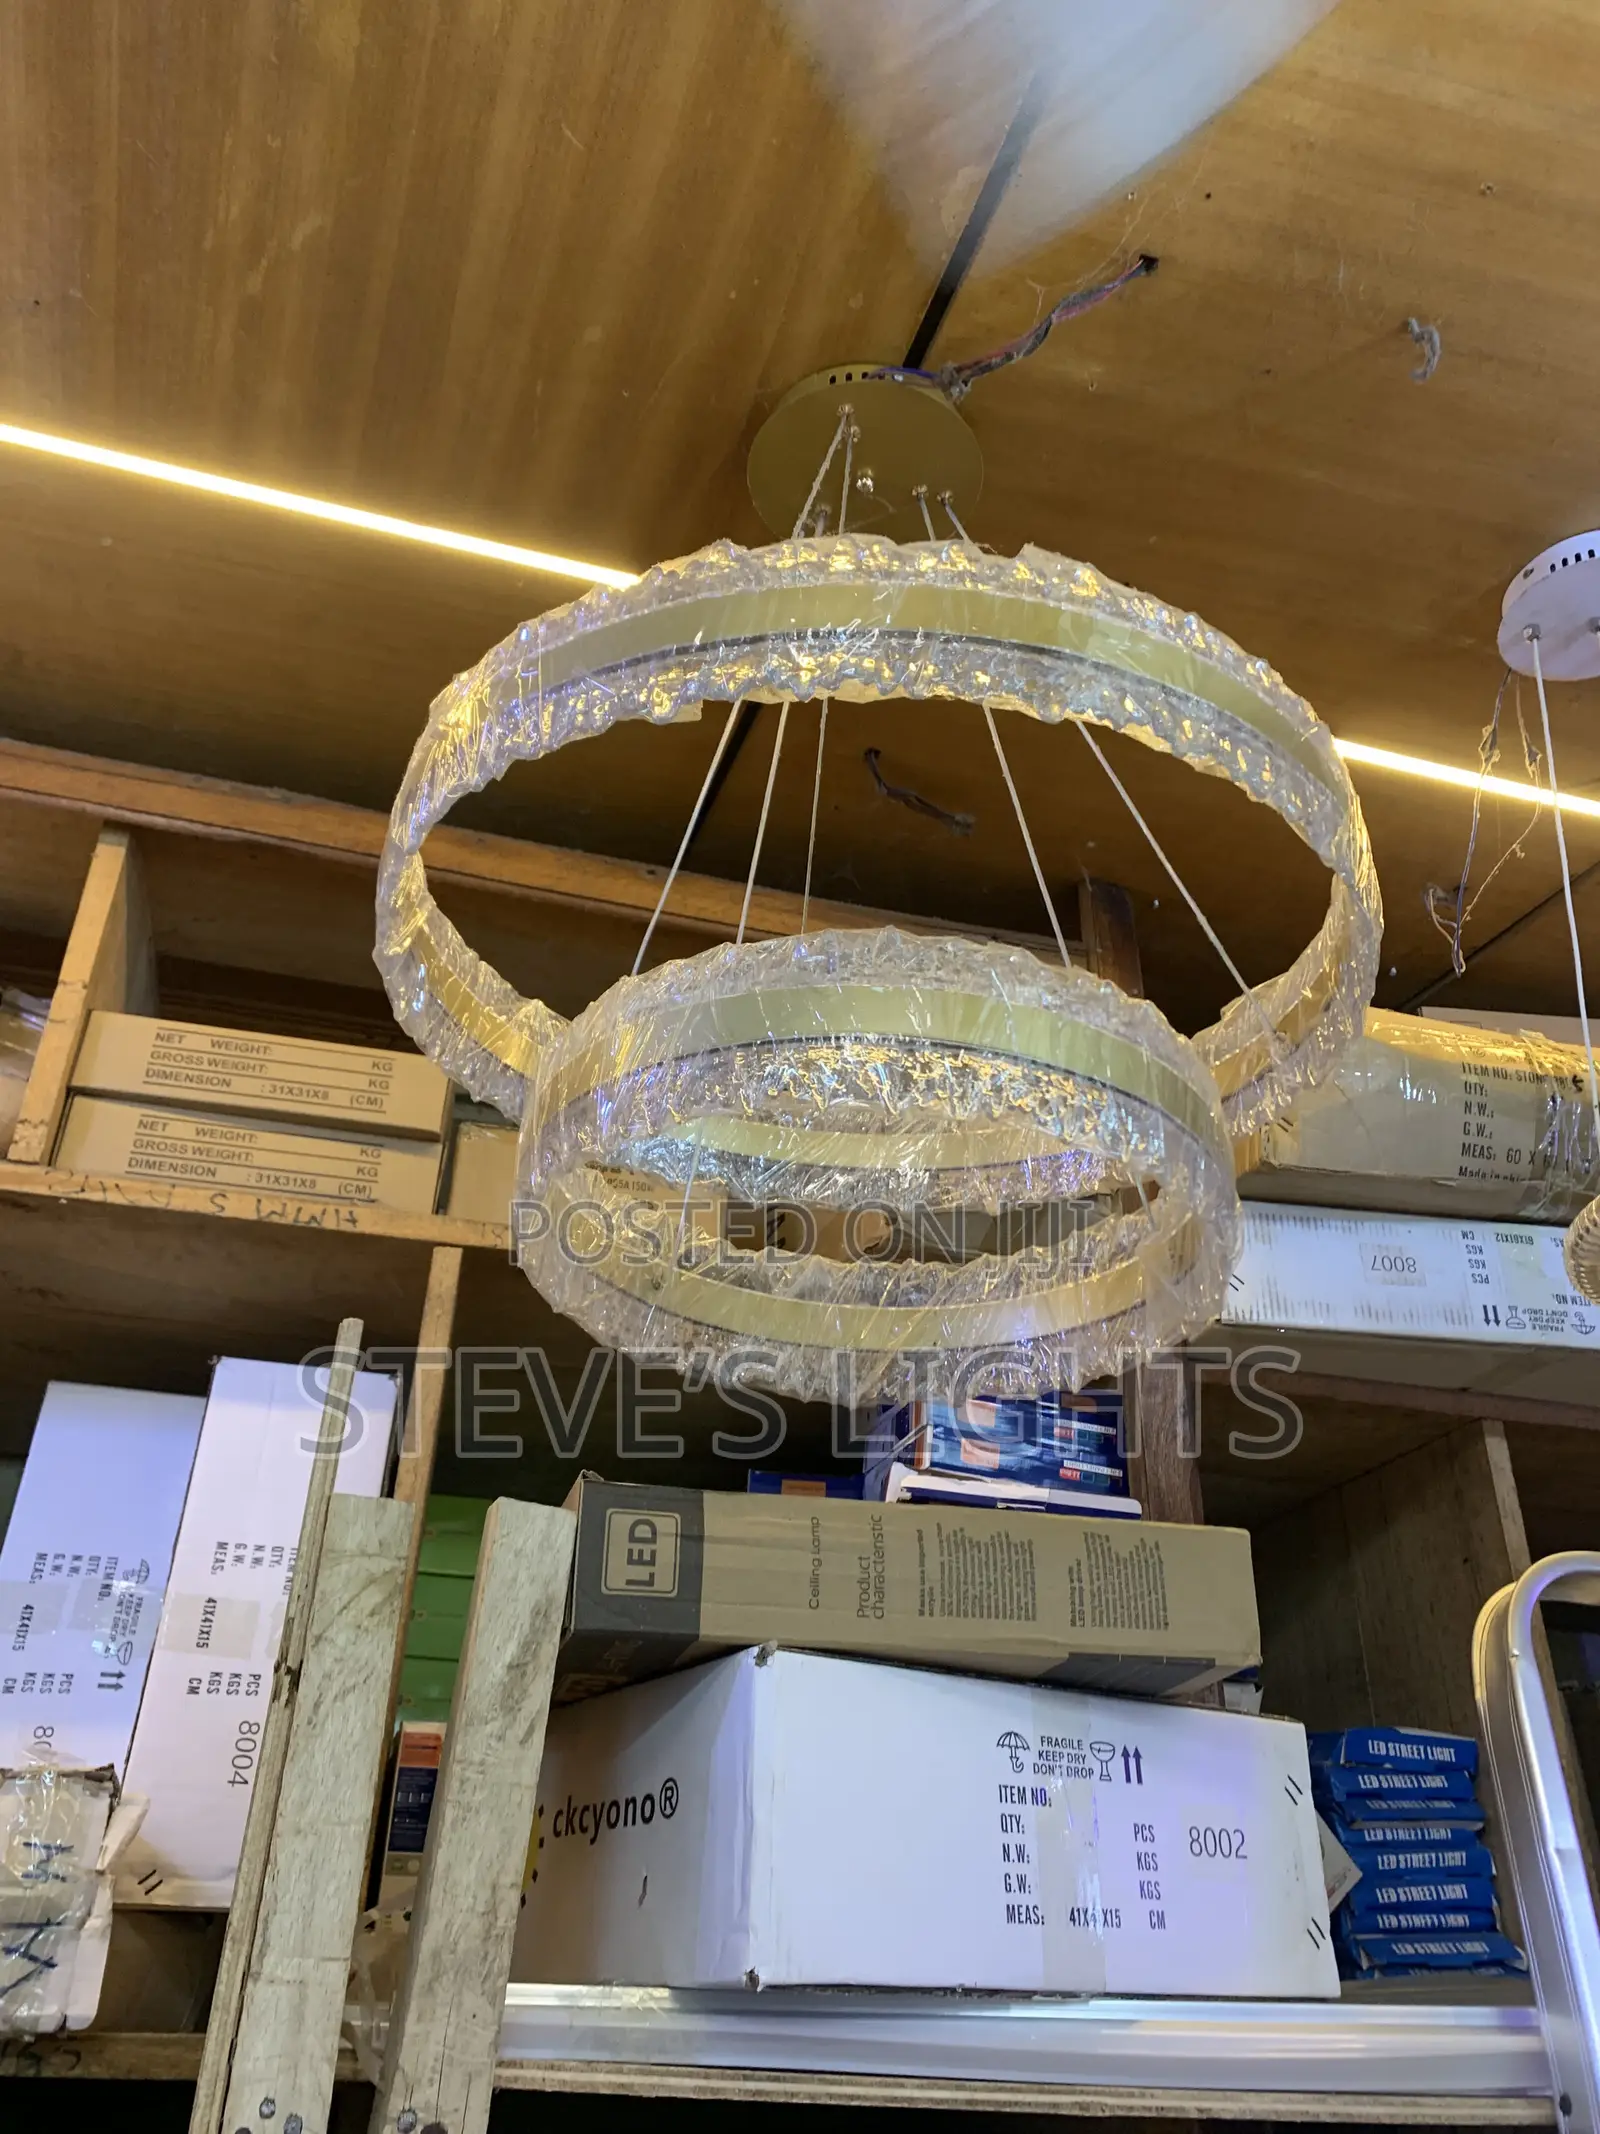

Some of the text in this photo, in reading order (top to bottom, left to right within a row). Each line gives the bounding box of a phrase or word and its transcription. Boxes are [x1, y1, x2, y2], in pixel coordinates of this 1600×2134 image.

[154, 1031, 393, 1072] NET WEIGHT: KG
[150, 1049, 390, 1090] GROSS WEIGHT: KG
[1461, 1062, 1490, 1078] ITEM
[1492, 1066, 1512, 1080] NO:
[145, 1067, 232, 1089] DIMENSION
[349, 1093, 385, 1109] (CM)
[1464, 1080, 1488, 1097] QTY:
[137, 1118, 382, 1159] NET WEIGHT: KG
[133, 1138, 378, 1178] GROSS WEIGHT: KG
[1461, 1141, 1496, 1161] MEAS:
[1506, 1148, 1521, 1164] 60
[1528, 1151, 1535, 1166] X
[127, 1156, 217, 1178] DIMENSION
[338, 1181, 373, 1198] (CM)
[1461, 1230, 1475, 1241] CM
[1466, 1243, 1484, 1255] KGS
[1370, 1254, 1417, 1274] 8007
[1468, 1258, 1486, 1269] KGS
[1472, 1272, 1490, 1284] PCS
[1521, 1307, 1544, 1317] DROP
[1528, 1315, 1565, 1324] KEEP DRY
[1532, 1322, 1564, 1333] FRAGILE
[809, 1516, 823, 1555] Lamp
[625, 1518, 658, 1588] LED
[916, 1529, 925, 1568] imported
[103, 1556, 119, 1581] ITEM
[870, 1514, 885, 1620] characteristic
[856, 1555, 870, 1619] Product
[1, 1552, 48, 1695] MEAS: 41X41X15 CM
[58, 1556, 101, 1695] QTY: PCS
[119, 1619, 130, 1638] DRY
[129, 1596, 144, 1637] FRAGILE
[186, 1541, 229, 1696] MEAS: 41X41X15 CM
[245, 1546, 285, 1697] QTY: PCS
[1077, 1608, 1086, 1628] LED
[109, 1620, 119, 1643] DROP
[21, 1671, 37, 1694] KGS
[39, 1672, 56, 1695] KGS
[206, 1671, 223, 1695] KGS
[226, 1672, 242, 1696] KGS
[227, 1720, 261, 1788] 8004
[1040, 1735, 1084, 1751] FRAGILE
[1368, 1739, 1456, 1763] LED STREET LIGHT
[1037, 1750, 1087, 1765] KEEP DRY
[1032, 1762, 1095, 1780] DON'T DROP
[1358, 1774, 1449, 1789] LED STREET LIGHT
[998, 1784, 1052, 1807] ITEM NO:
[1000, 1813, 1156, 1843] QTY: PCS
[1188, 1825, 1248, 1860] 8002
[1002, 1843, 1159, 1872] N.W: KGS
[1377, 1850, 1467, 1871] LED STREET LIGHT
[1004, 1873, 1162, 1901] G.W: KGS
[1375, 1883, 1468, 1904] LED STREET LIGHT
[1006, 1903, 1045, 1926] MEAS:
[1149, 1910, 1167, 1930] CM
[1377, 1914, 1398, 1929] LED
